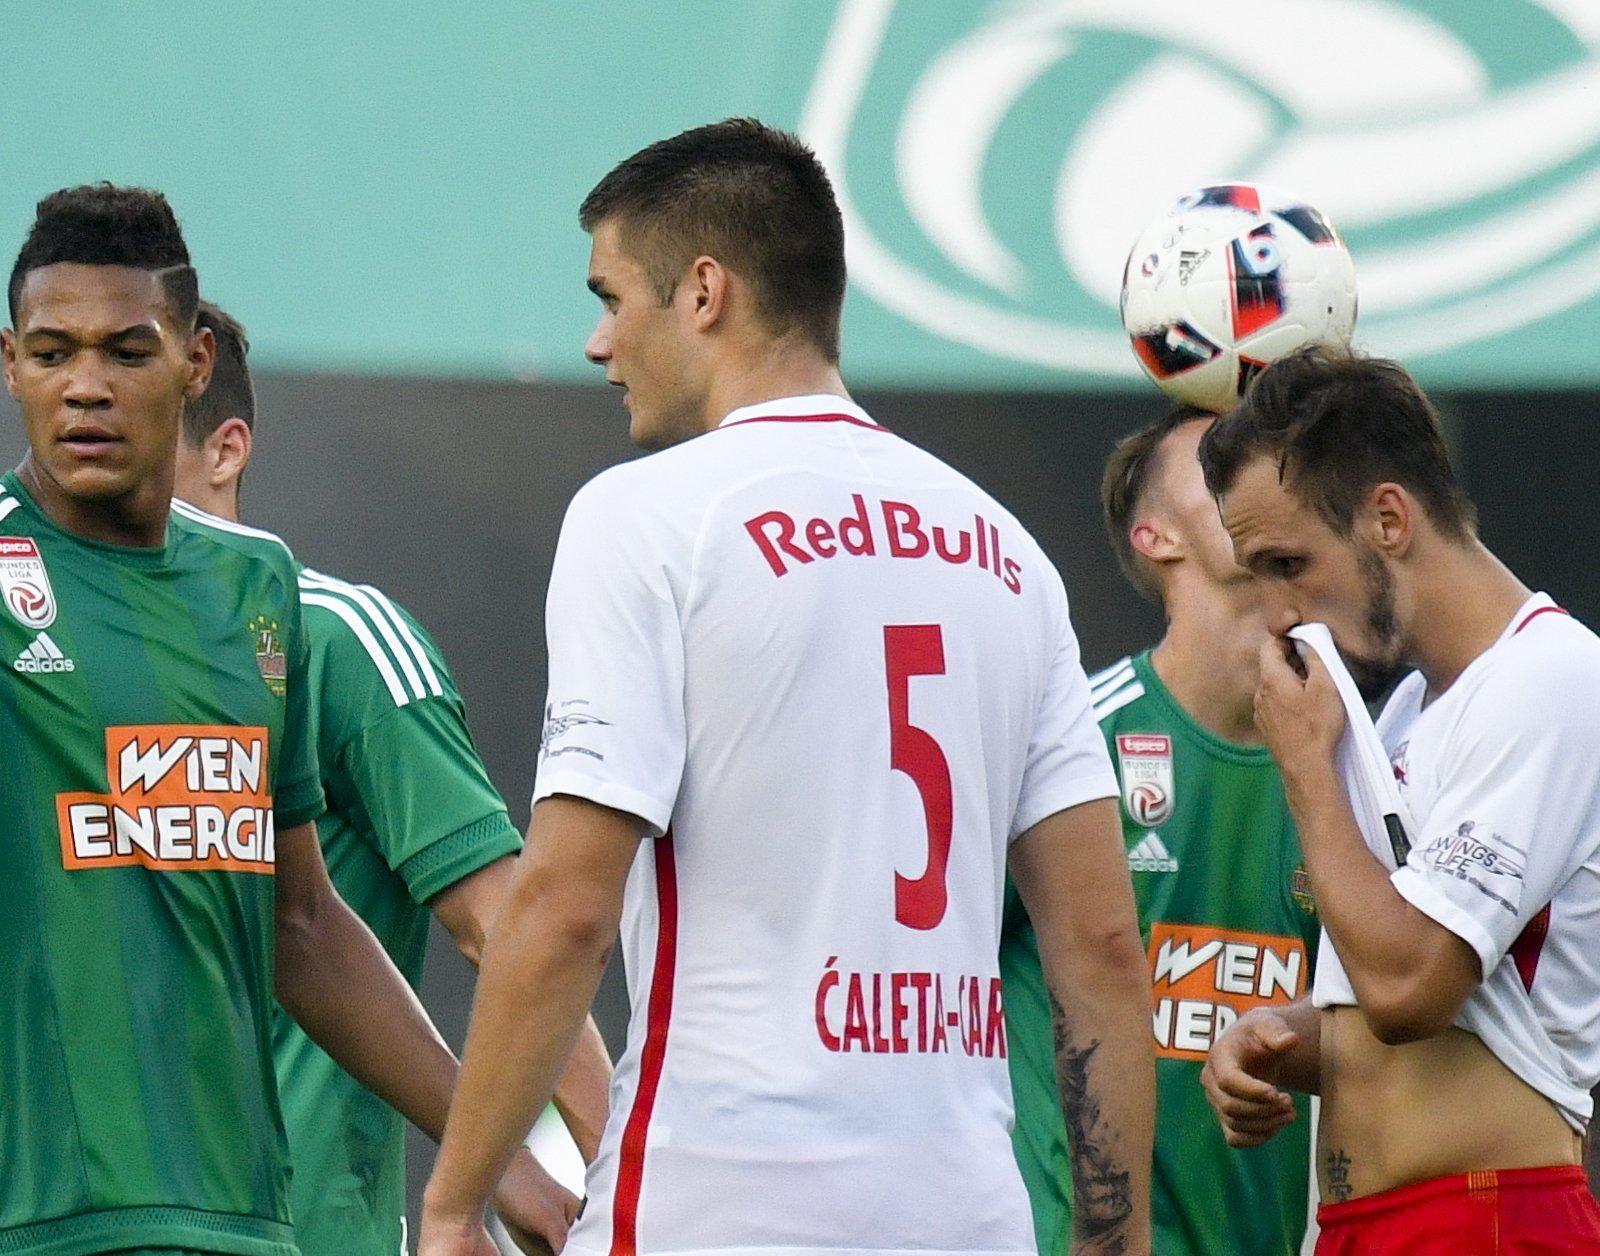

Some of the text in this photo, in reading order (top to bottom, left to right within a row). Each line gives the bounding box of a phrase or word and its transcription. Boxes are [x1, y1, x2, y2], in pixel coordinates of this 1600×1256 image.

[8, 571, 33, 579] LIGA
[745, 494, 1023, 596] Red Bulls
[13, 658, 75, 674] adidas
[118, 735, 262, 796] WIEN
[882, 624, 954, 932] 5
